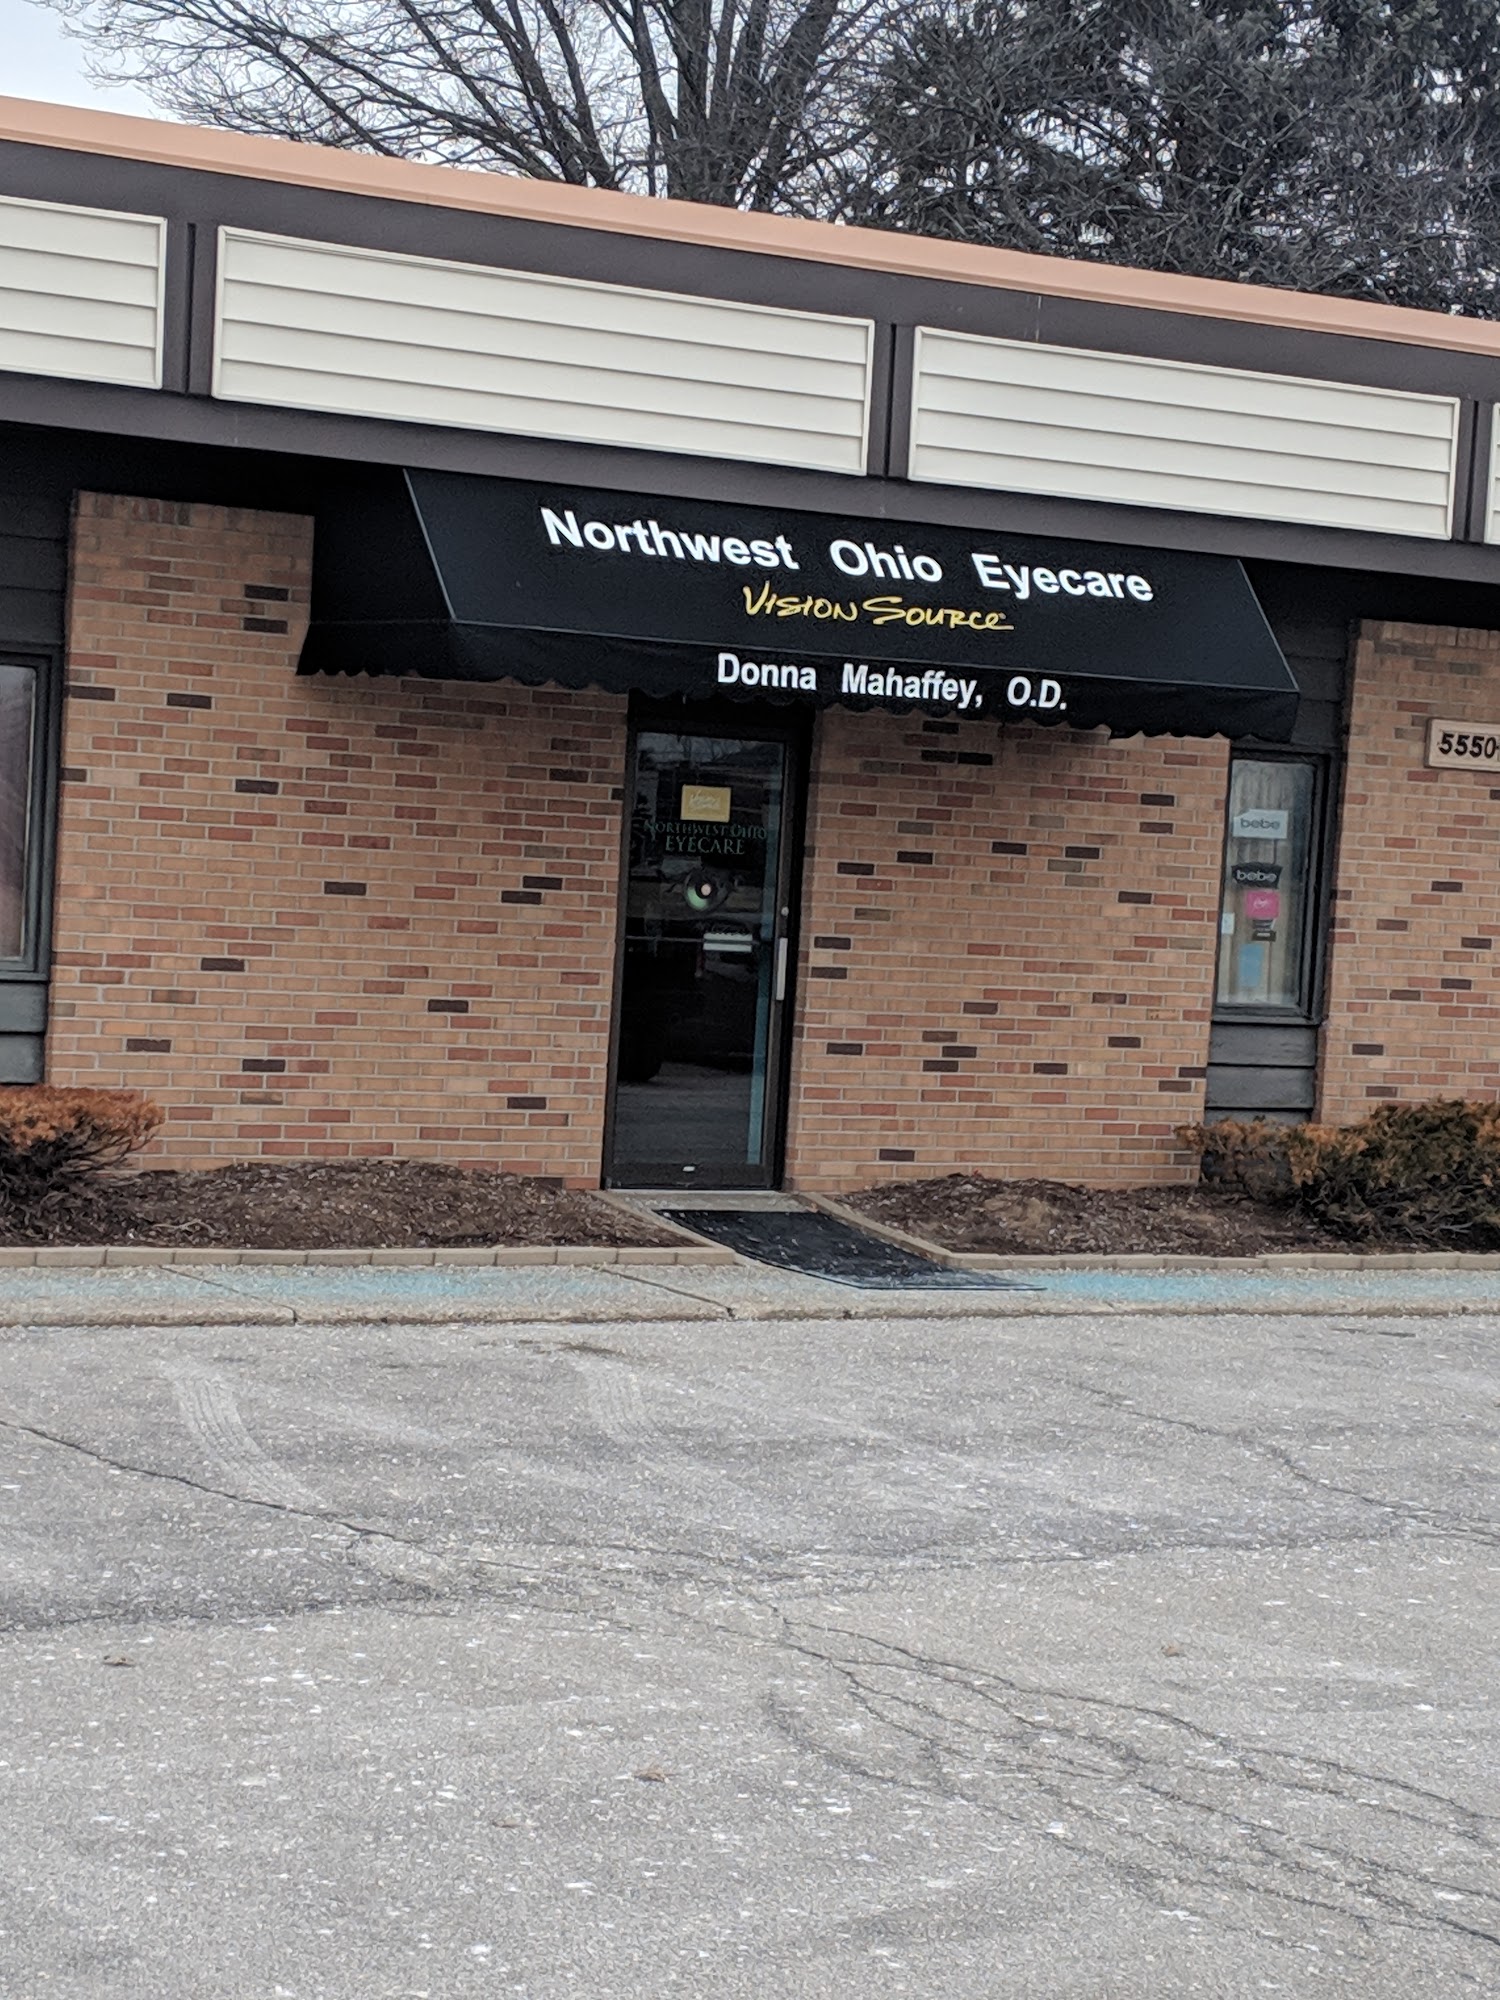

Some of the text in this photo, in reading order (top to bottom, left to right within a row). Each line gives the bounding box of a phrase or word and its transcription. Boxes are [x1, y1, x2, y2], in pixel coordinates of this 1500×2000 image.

[540, 507, 1154, 602] Northwest Ohio Eyecare
[716, 653, 1068, 710] Donna Mahaffey, O.D.
[645, 820, 726, 836] NORTHWEST
[1240, 817, 1281, 830] bebe
[664, 836, 746, 855] EYECARE
[1236, 869, 1278, 883] bebe
